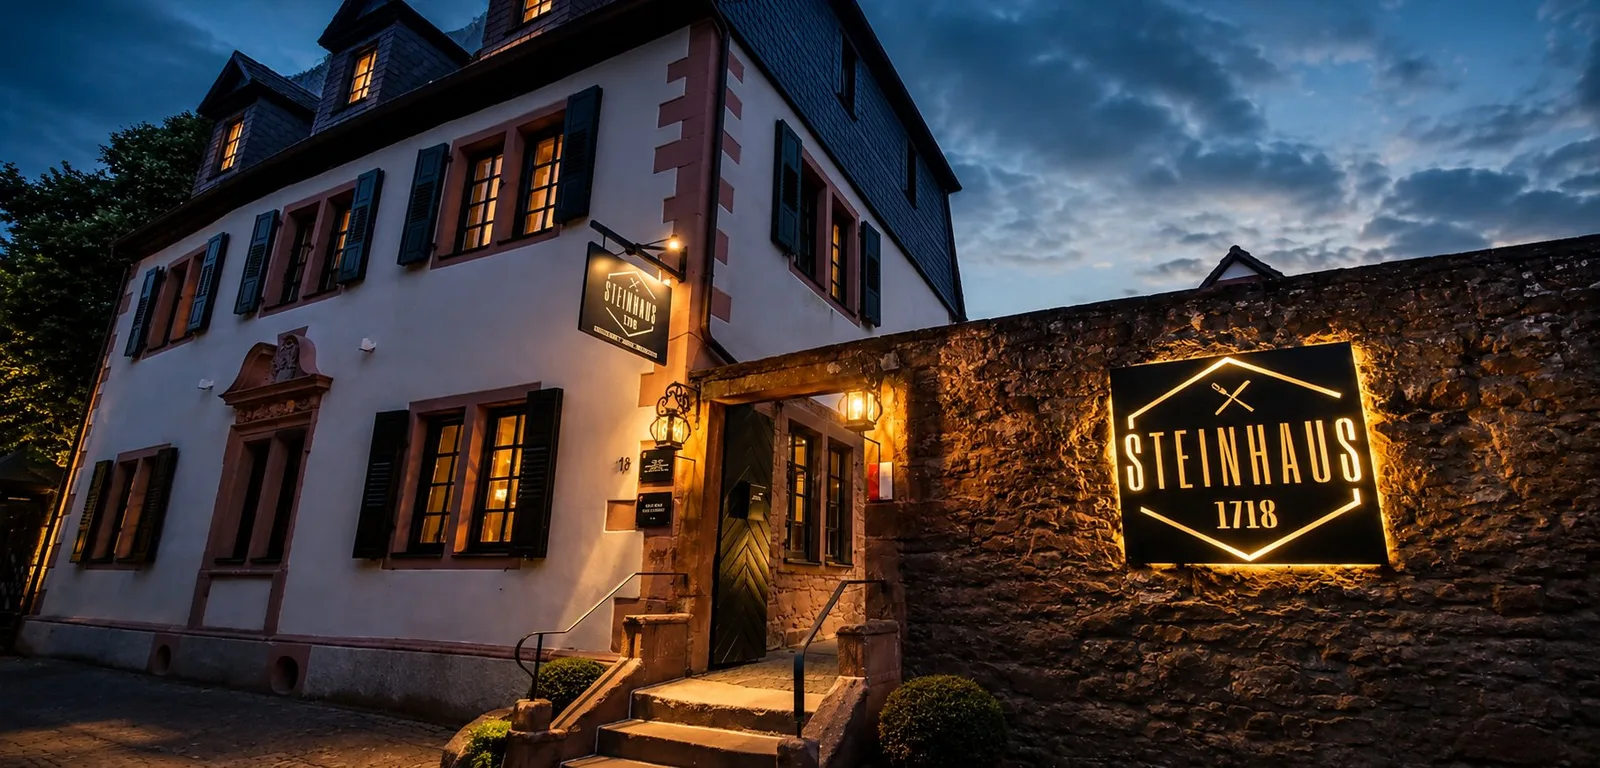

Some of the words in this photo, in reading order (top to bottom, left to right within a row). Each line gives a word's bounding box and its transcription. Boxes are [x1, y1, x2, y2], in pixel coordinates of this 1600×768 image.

[604, 280, 657, 325] STEINHAUS
[1124, 417, 1362, 492] STEINHAUS
[1214, 499, 1279, 530] 1718
